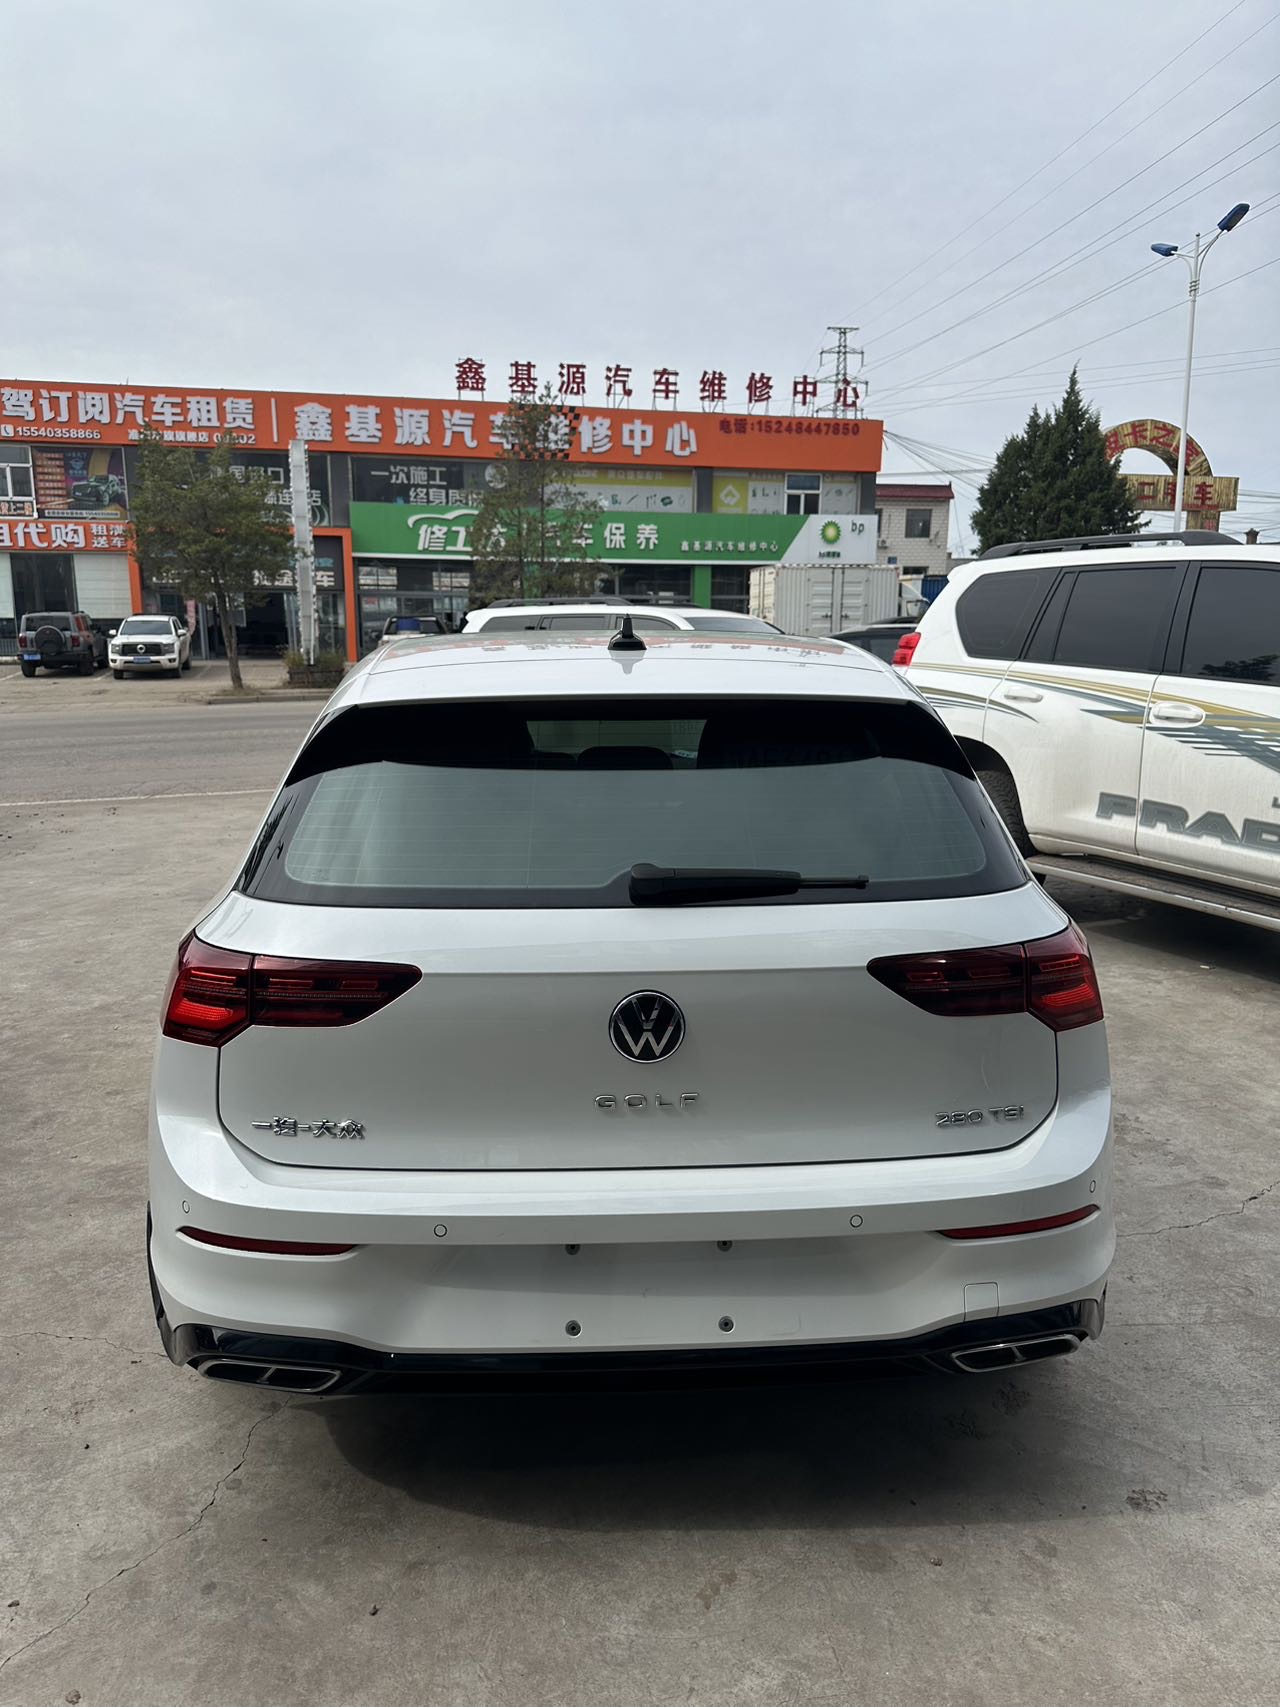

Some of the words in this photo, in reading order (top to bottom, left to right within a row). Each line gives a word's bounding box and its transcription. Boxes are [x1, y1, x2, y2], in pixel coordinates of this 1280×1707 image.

[455, 357, 860, 408] 鑫基源汽车维修中心
[1, 388, 255, 430] 驾订阅汽车租赁
[16, 427, 101, 440] 15540358866
[294, 402, 698, 457] 鑫基源汽车维修中心
[371, 466, 447, 485] 一次施工
[851, 520, 865, 535] bp
[594, 1093, 700, 1110] GOLF
[935, 1109, 983, 1127] 280
[987, 1105, 1024, 1121] TSI
